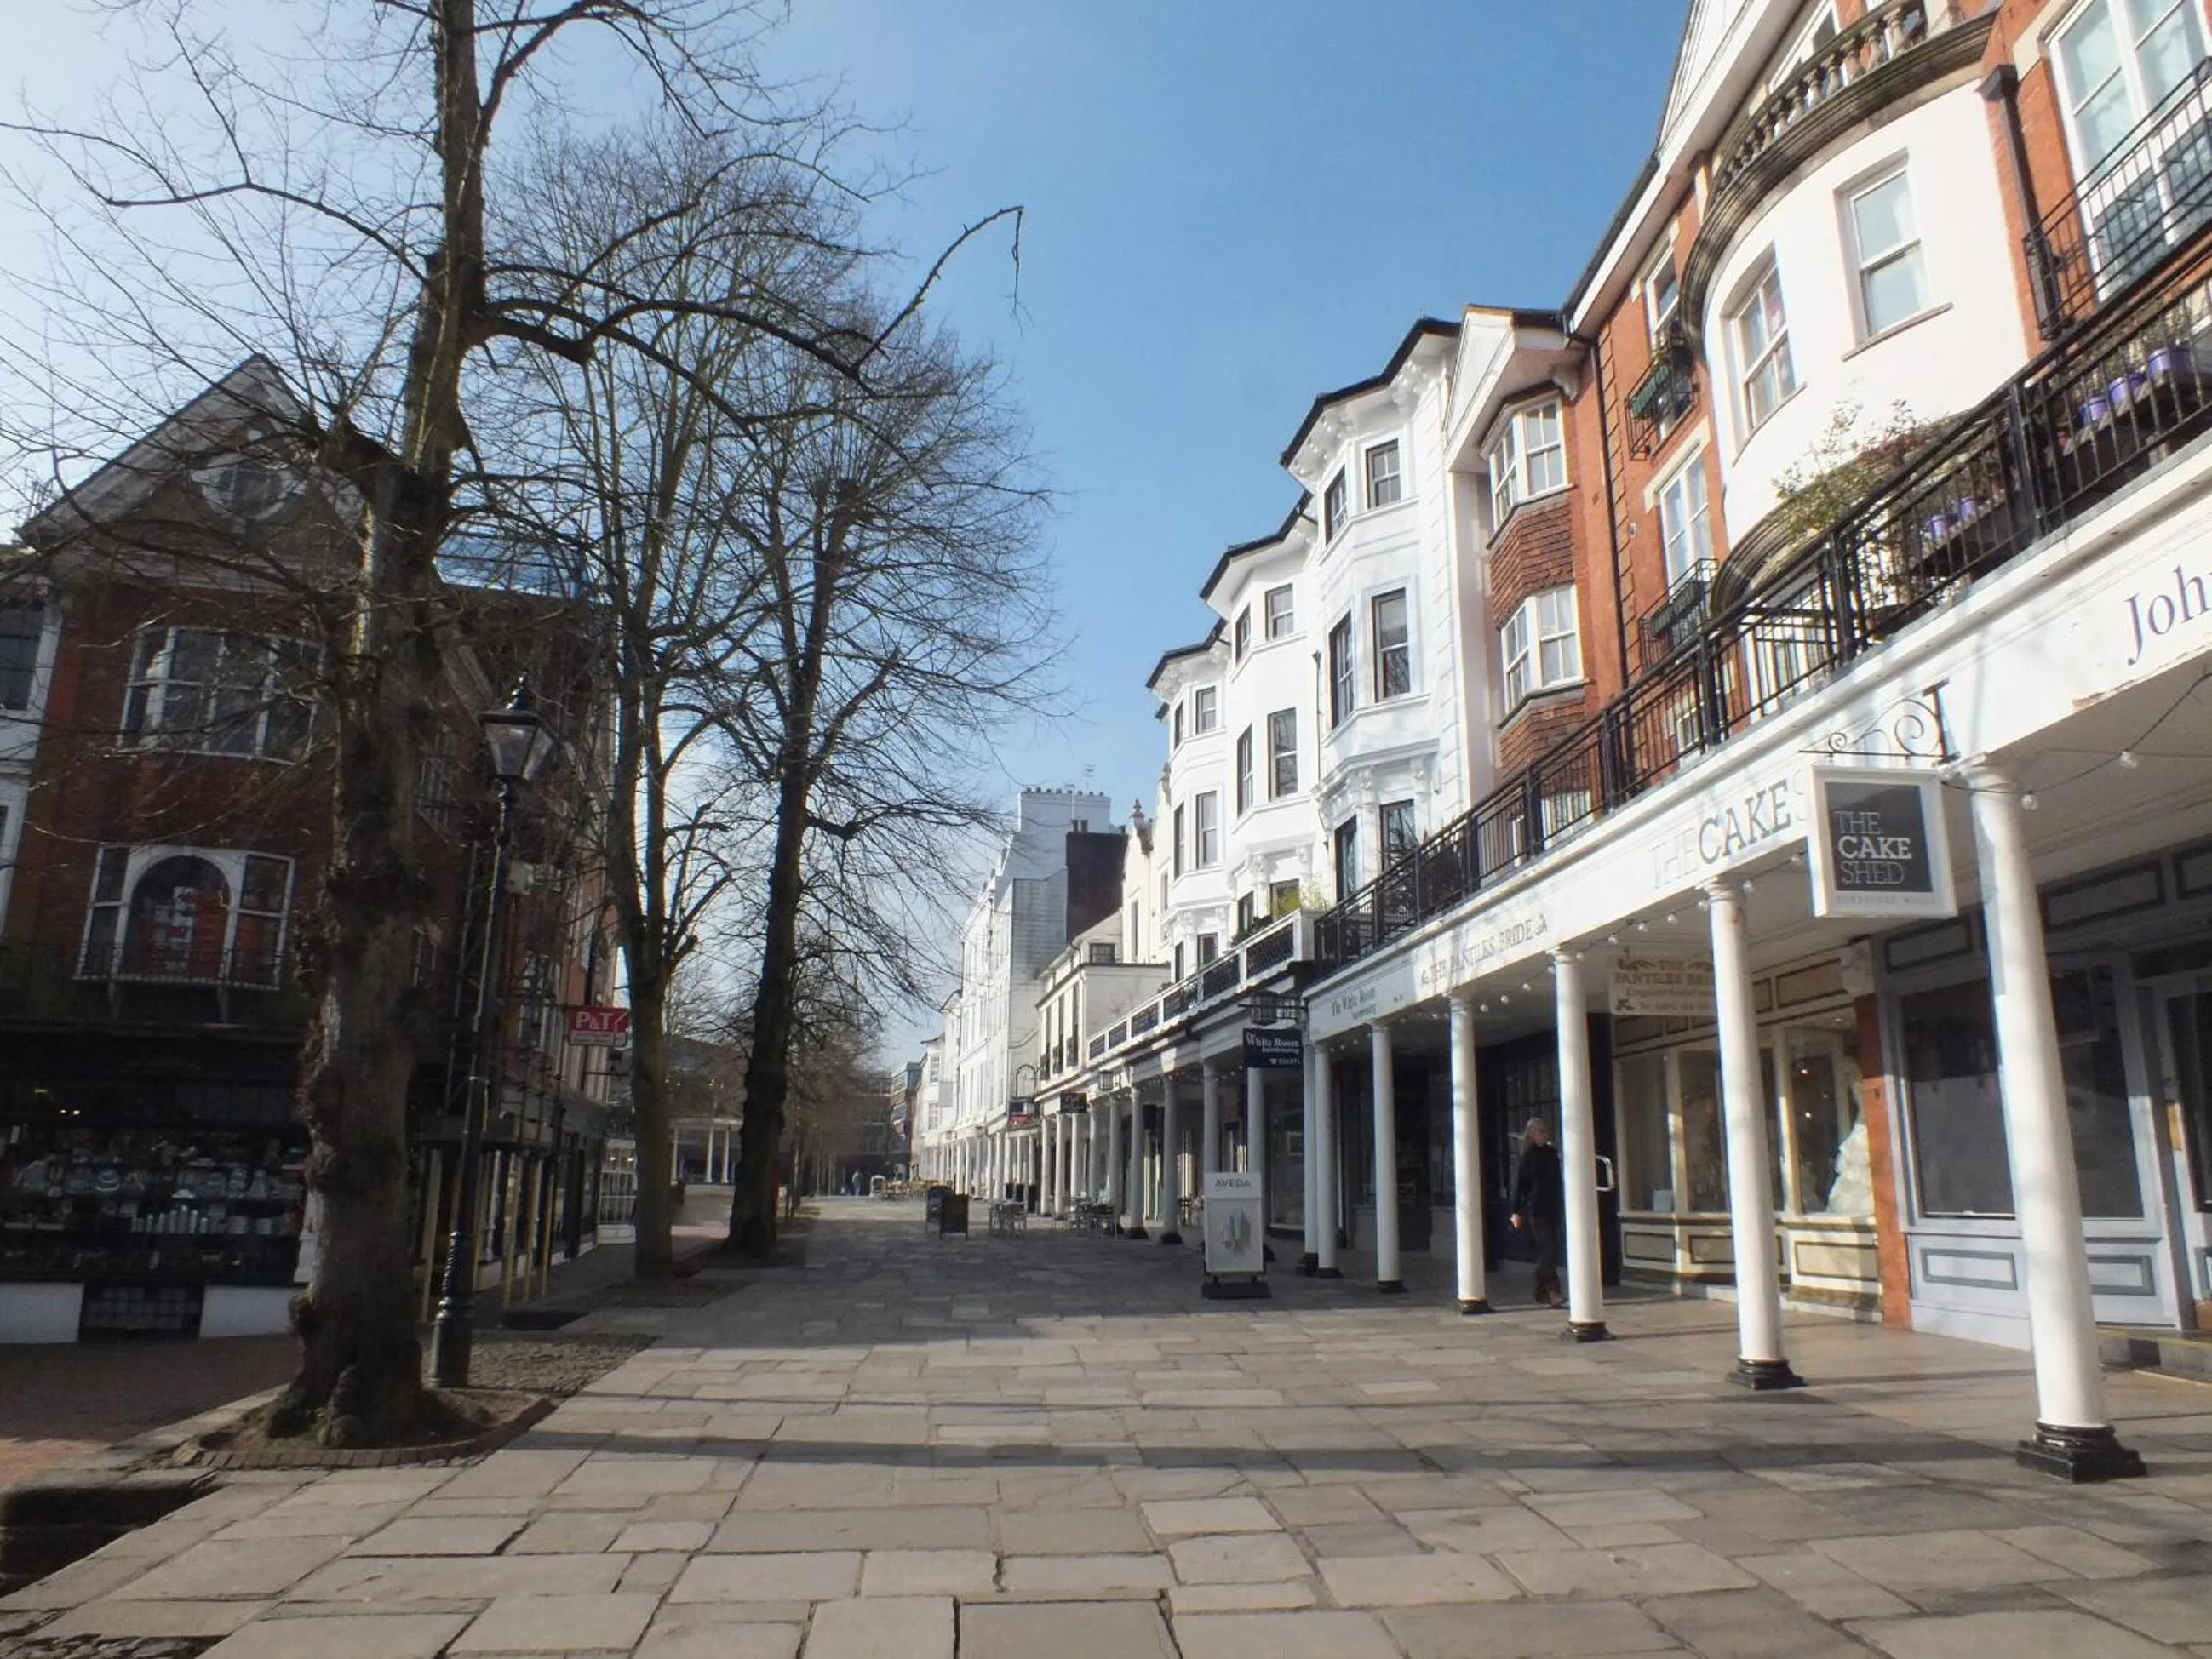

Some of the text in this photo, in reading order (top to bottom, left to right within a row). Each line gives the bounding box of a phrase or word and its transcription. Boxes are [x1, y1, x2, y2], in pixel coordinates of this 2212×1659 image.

[2123, 565, 2212, 666] Joh
[1699, 778, 1791, 864] CAKE
[1834, 810, 1882, 834] THE
[1839, 835, 1912, 859] CAKE
[1841, 860, 1905, 884] SHED
[1499, 920, 1533, 952] BRIDE
[1215, 1178, 1251, 1188] AVEDA
